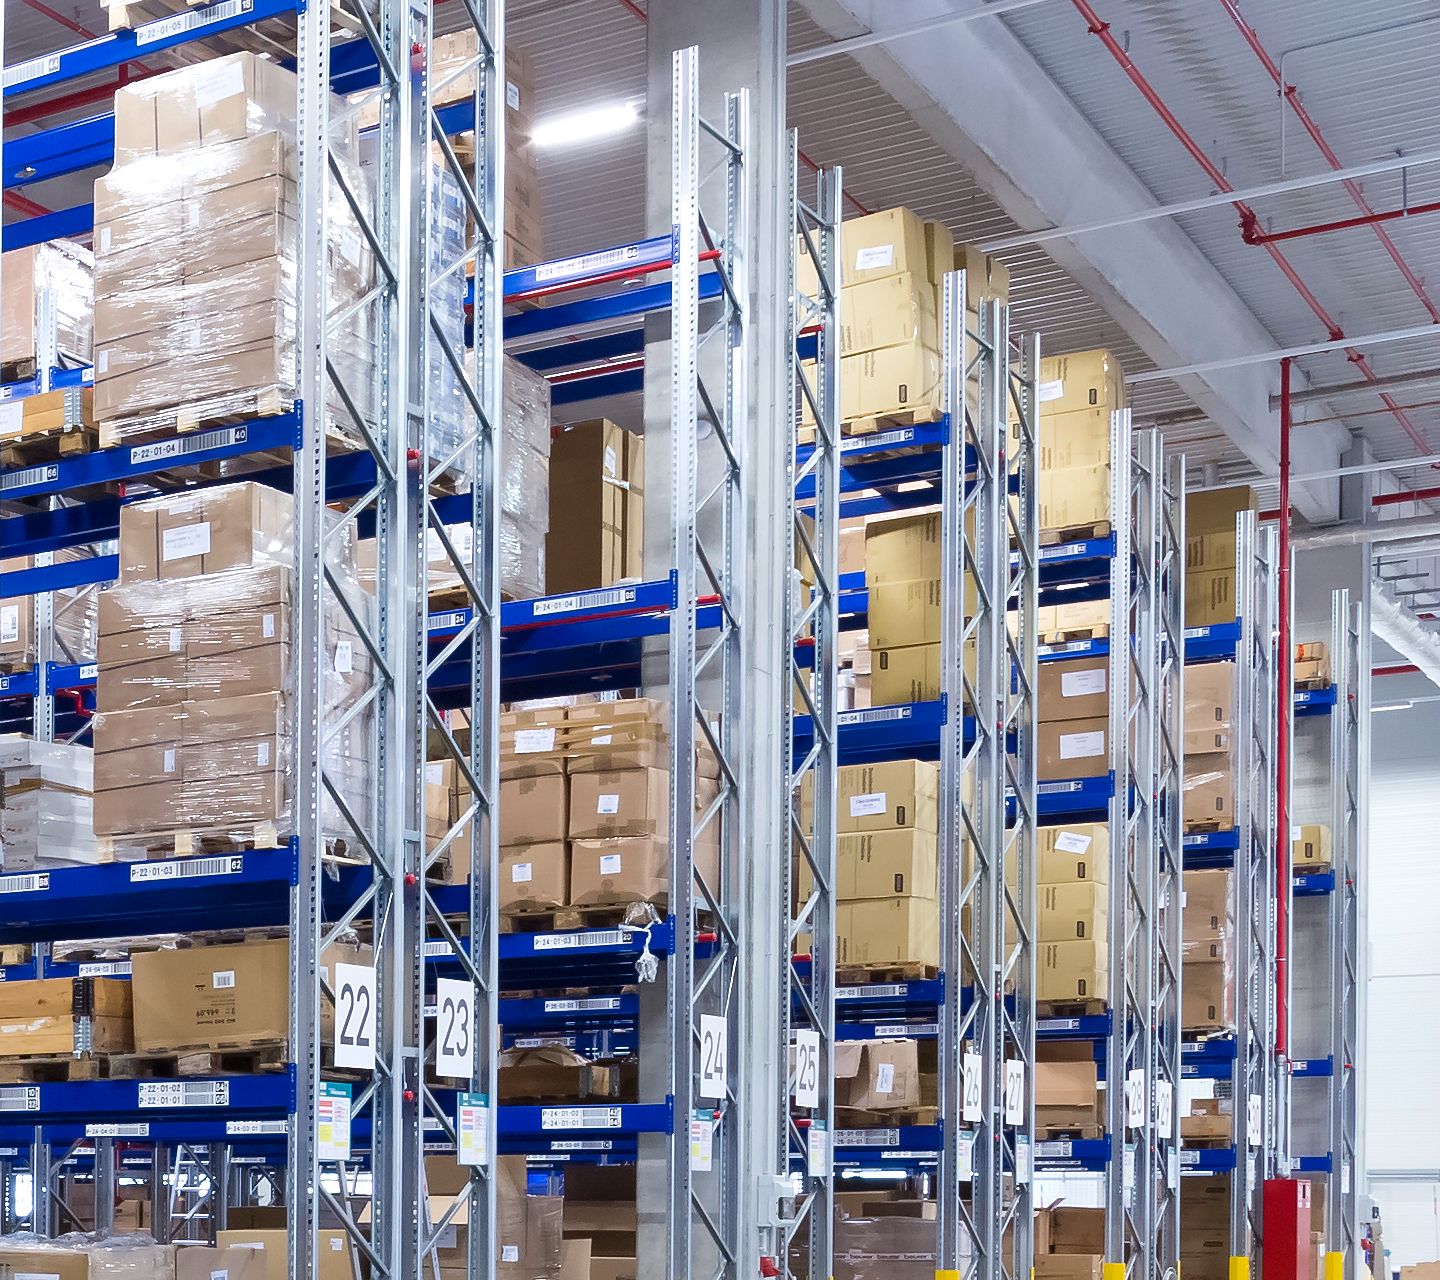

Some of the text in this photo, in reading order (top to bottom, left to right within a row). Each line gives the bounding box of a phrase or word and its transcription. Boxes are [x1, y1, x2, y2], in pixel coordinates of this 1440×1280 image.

[139, 0, 252, 42] P-22-01-05 18
[132, 429, 246, 460] P-22-01-04 40
[47, 467, 57, 478] 66
[455, 615, 464, 625] 24
[535, 600, 573, 613] P-24-01-04
[132, 859, 242, 878] P-22-01-03 62
[535, 933, 632, 947] P-24-01-03 20
[340, 983, 370, 1046] 22
[442, 997, 468, 1057] 23
[704, 1031, 723, 1080] 24
[799, 1043, 816, 1090] 25
[140, 1084, 181, 1093] P-22-01-02
[140, 1095, 181, 1104] P-22-01-01
[966, 1066, 979, 1107] 26
[1009, 1072, 1021, 1110] 27
[1131, 1081, 1143, 1116] 28
[1160, 1092, 1170, 1126] 29
